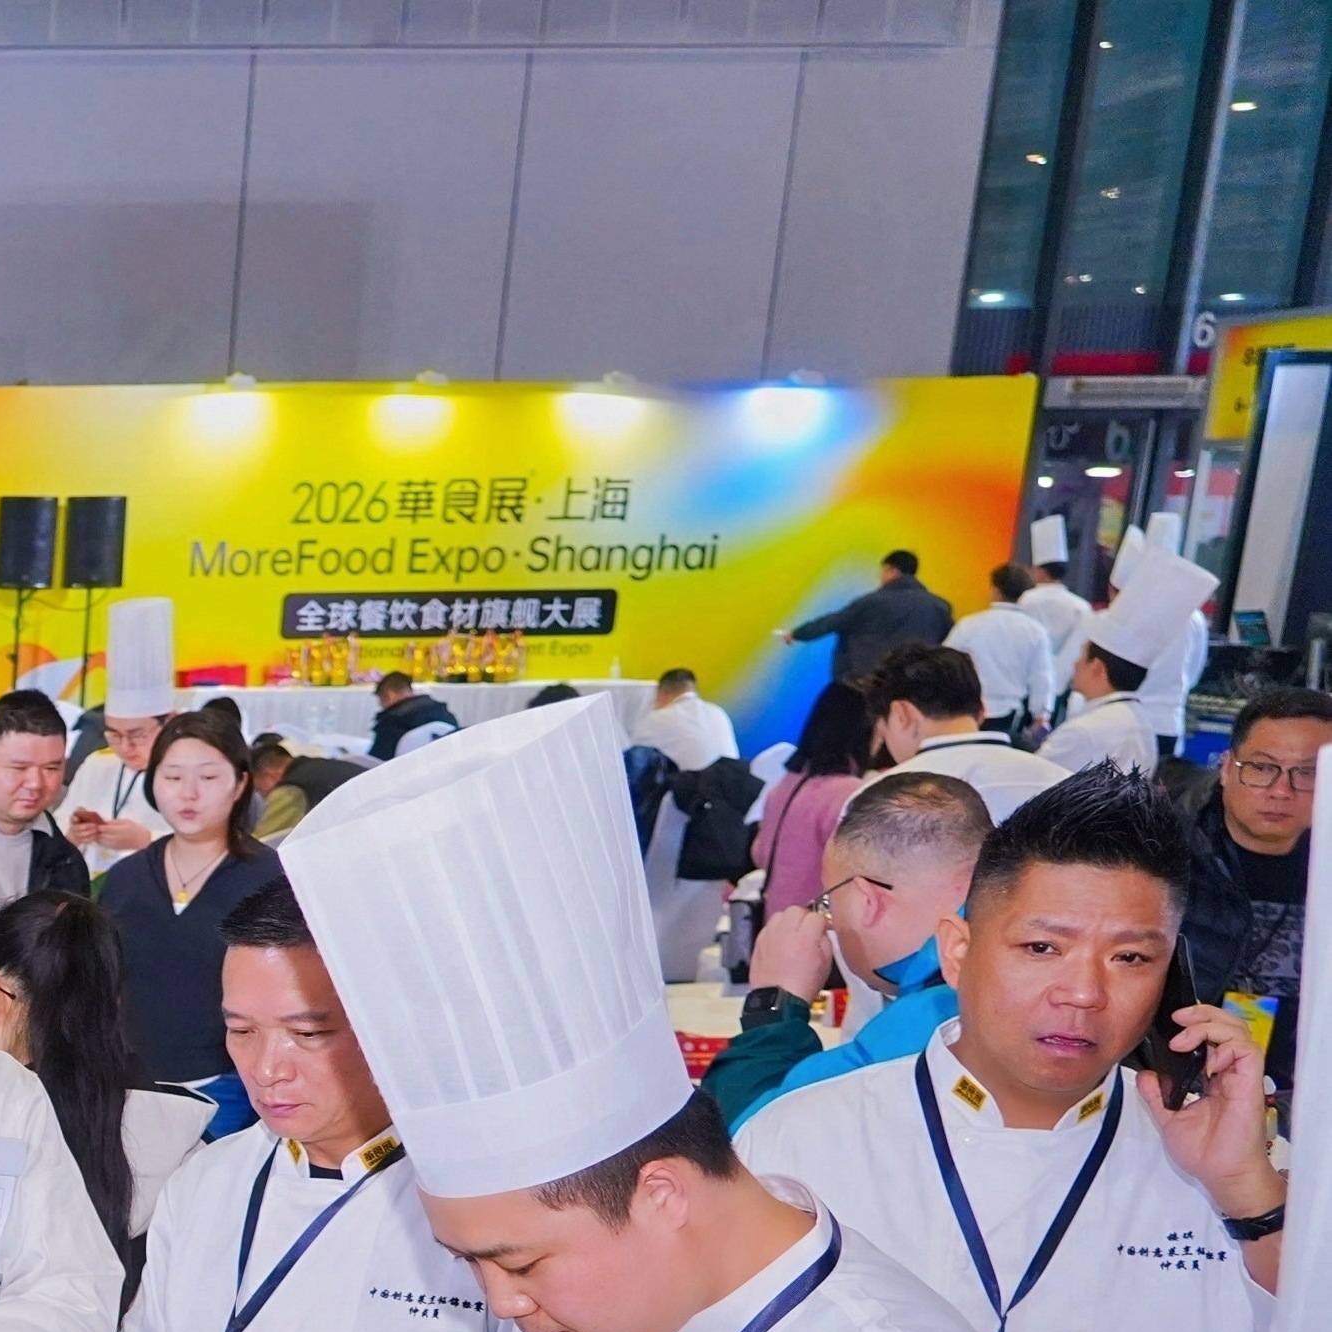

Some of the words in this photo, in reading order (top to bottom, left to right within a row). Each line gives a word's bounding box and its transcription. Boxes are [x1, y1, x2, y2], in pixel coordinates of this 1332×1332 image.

[189, 537, 395, 579] MoreFood
[295, 597, 603, 632] 全球餐饮食材旗舰大展
